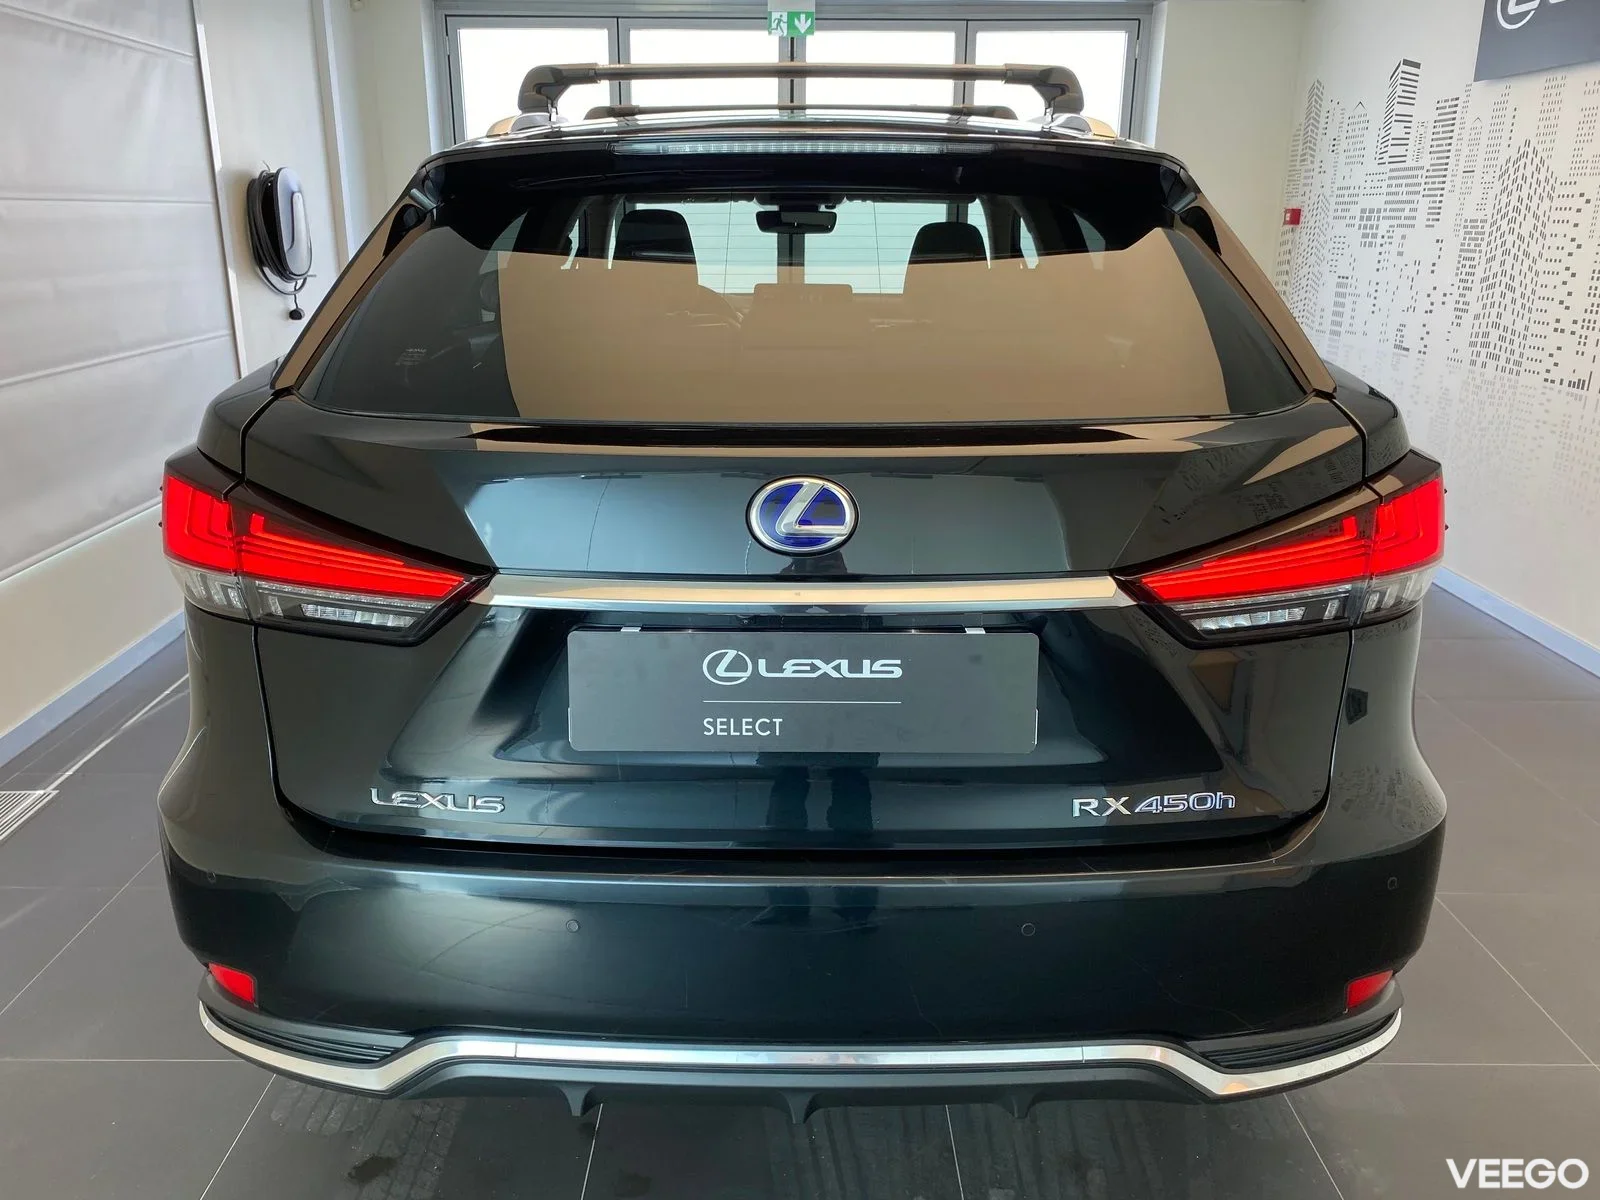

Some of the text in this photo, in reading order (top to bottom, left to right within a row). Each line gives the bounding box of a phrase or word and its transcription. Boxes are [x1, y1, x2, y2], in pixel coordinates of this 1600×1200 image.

[758, 659, 903, 679] LEXUS
[703, 718, 783, 736] SELECT
[370, 787, 505, 813] LEXUS
[1072, 791, 1236, 818] RX 450h
